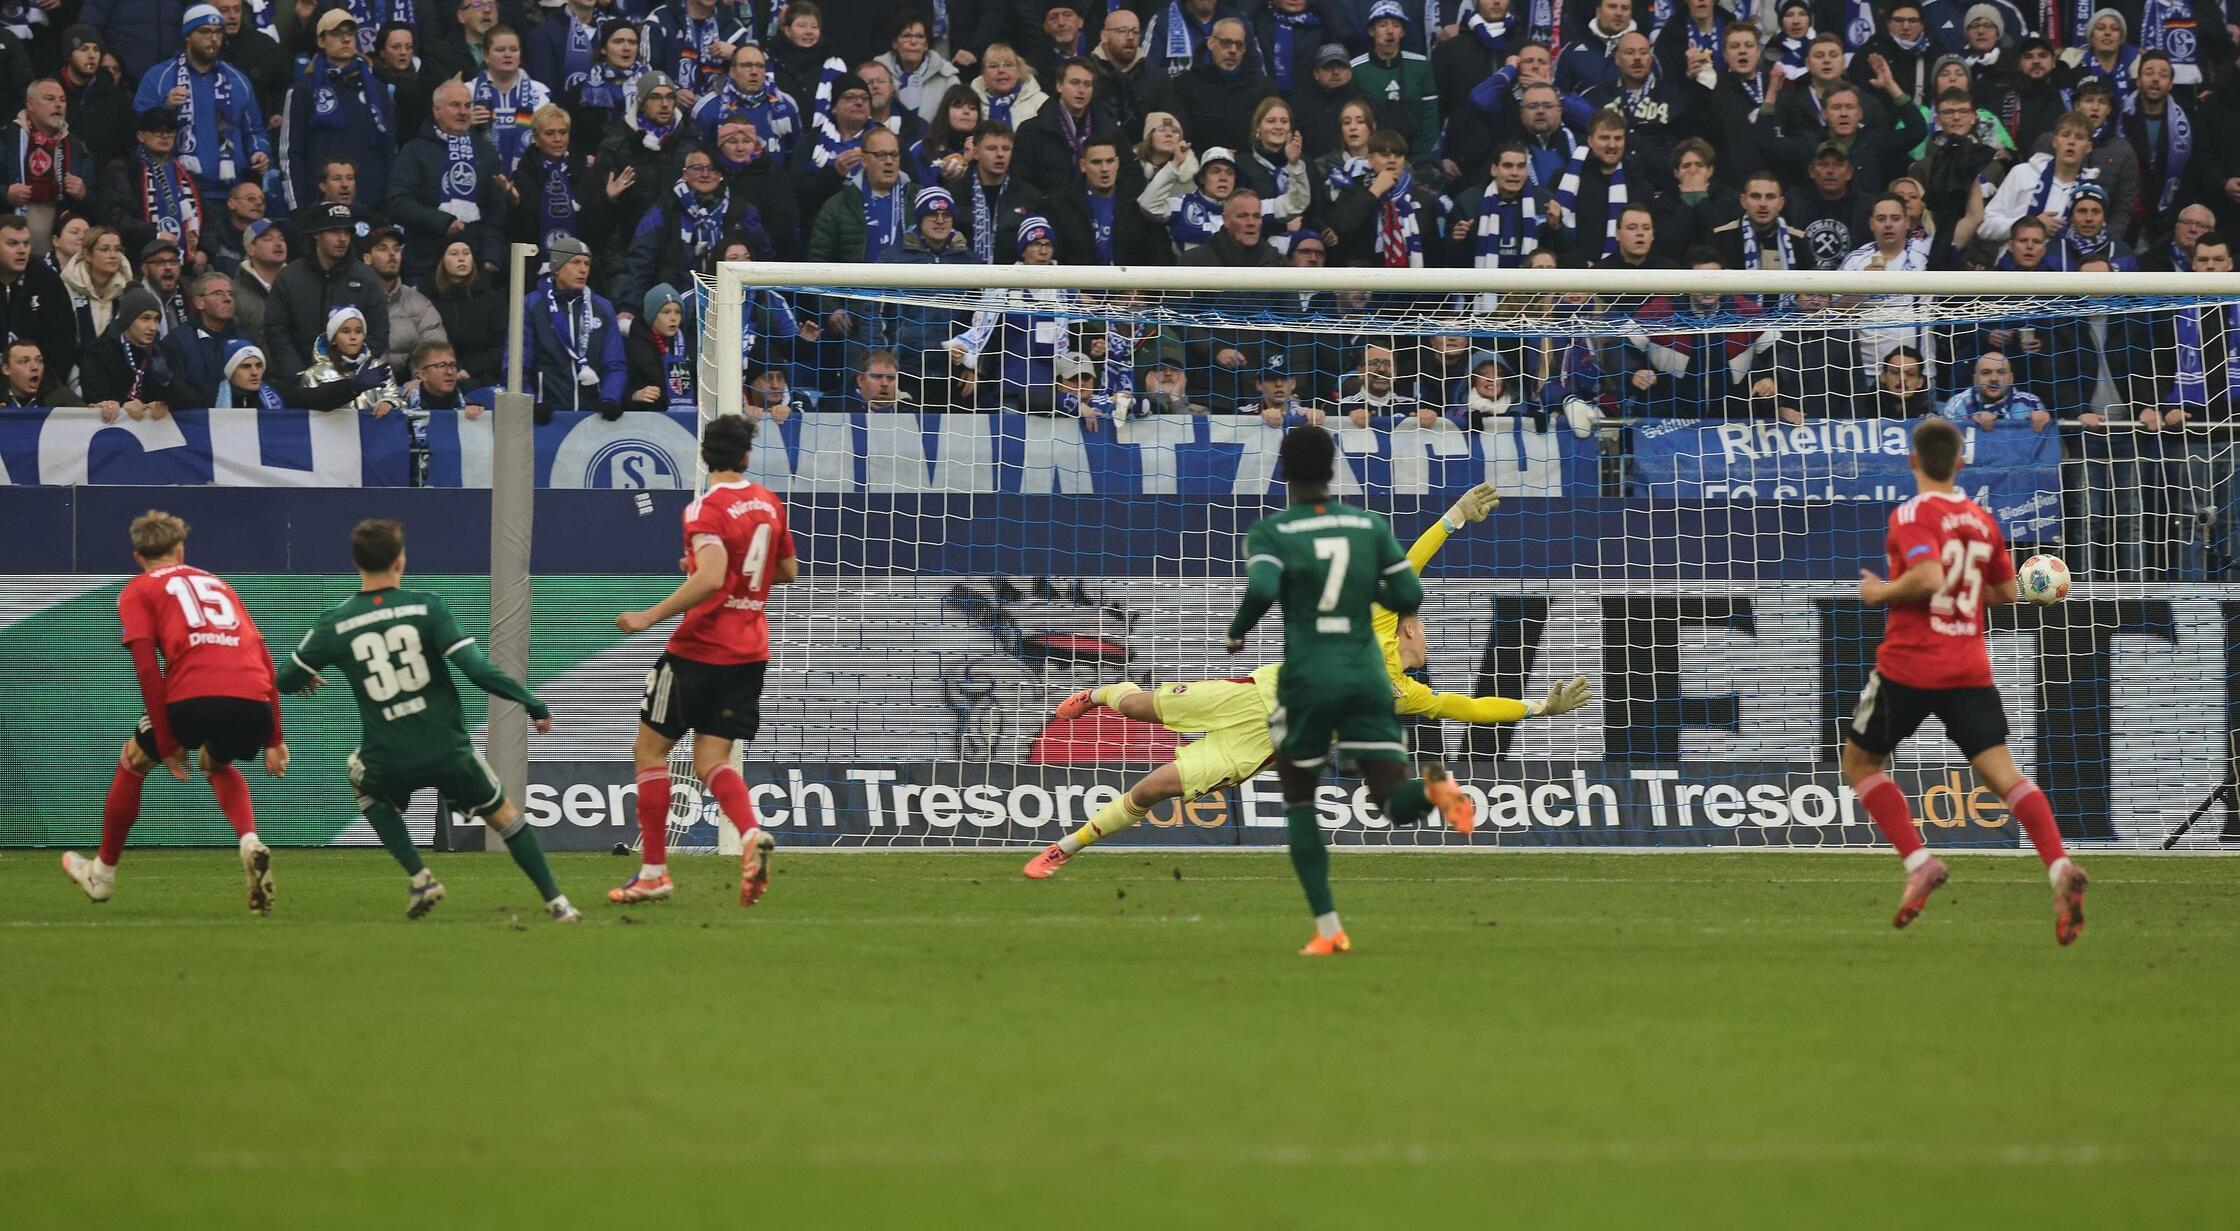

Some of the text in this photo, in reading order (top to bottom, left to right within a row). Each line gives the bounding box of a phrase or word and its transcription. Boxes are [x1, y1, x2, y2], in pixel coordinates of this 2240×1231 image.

[1717, 417, 1976, 464] Rheinla
[742, 523, 772, 592] 4
[1313, 536, 1350, 612] 7
[1930, 538, 1993, 619] 25
[165, 576, 241, 631] 15
[1931, 615, 1977, 636] Becke
[188, 632, 241, 648] Drexler
[351, 624, 431, 701] 33
[452, 769, 836, 828] senbch
[1240, 770, 1620, 828] Eseach
[1631, 769, 2010, 828] Tresor.de
